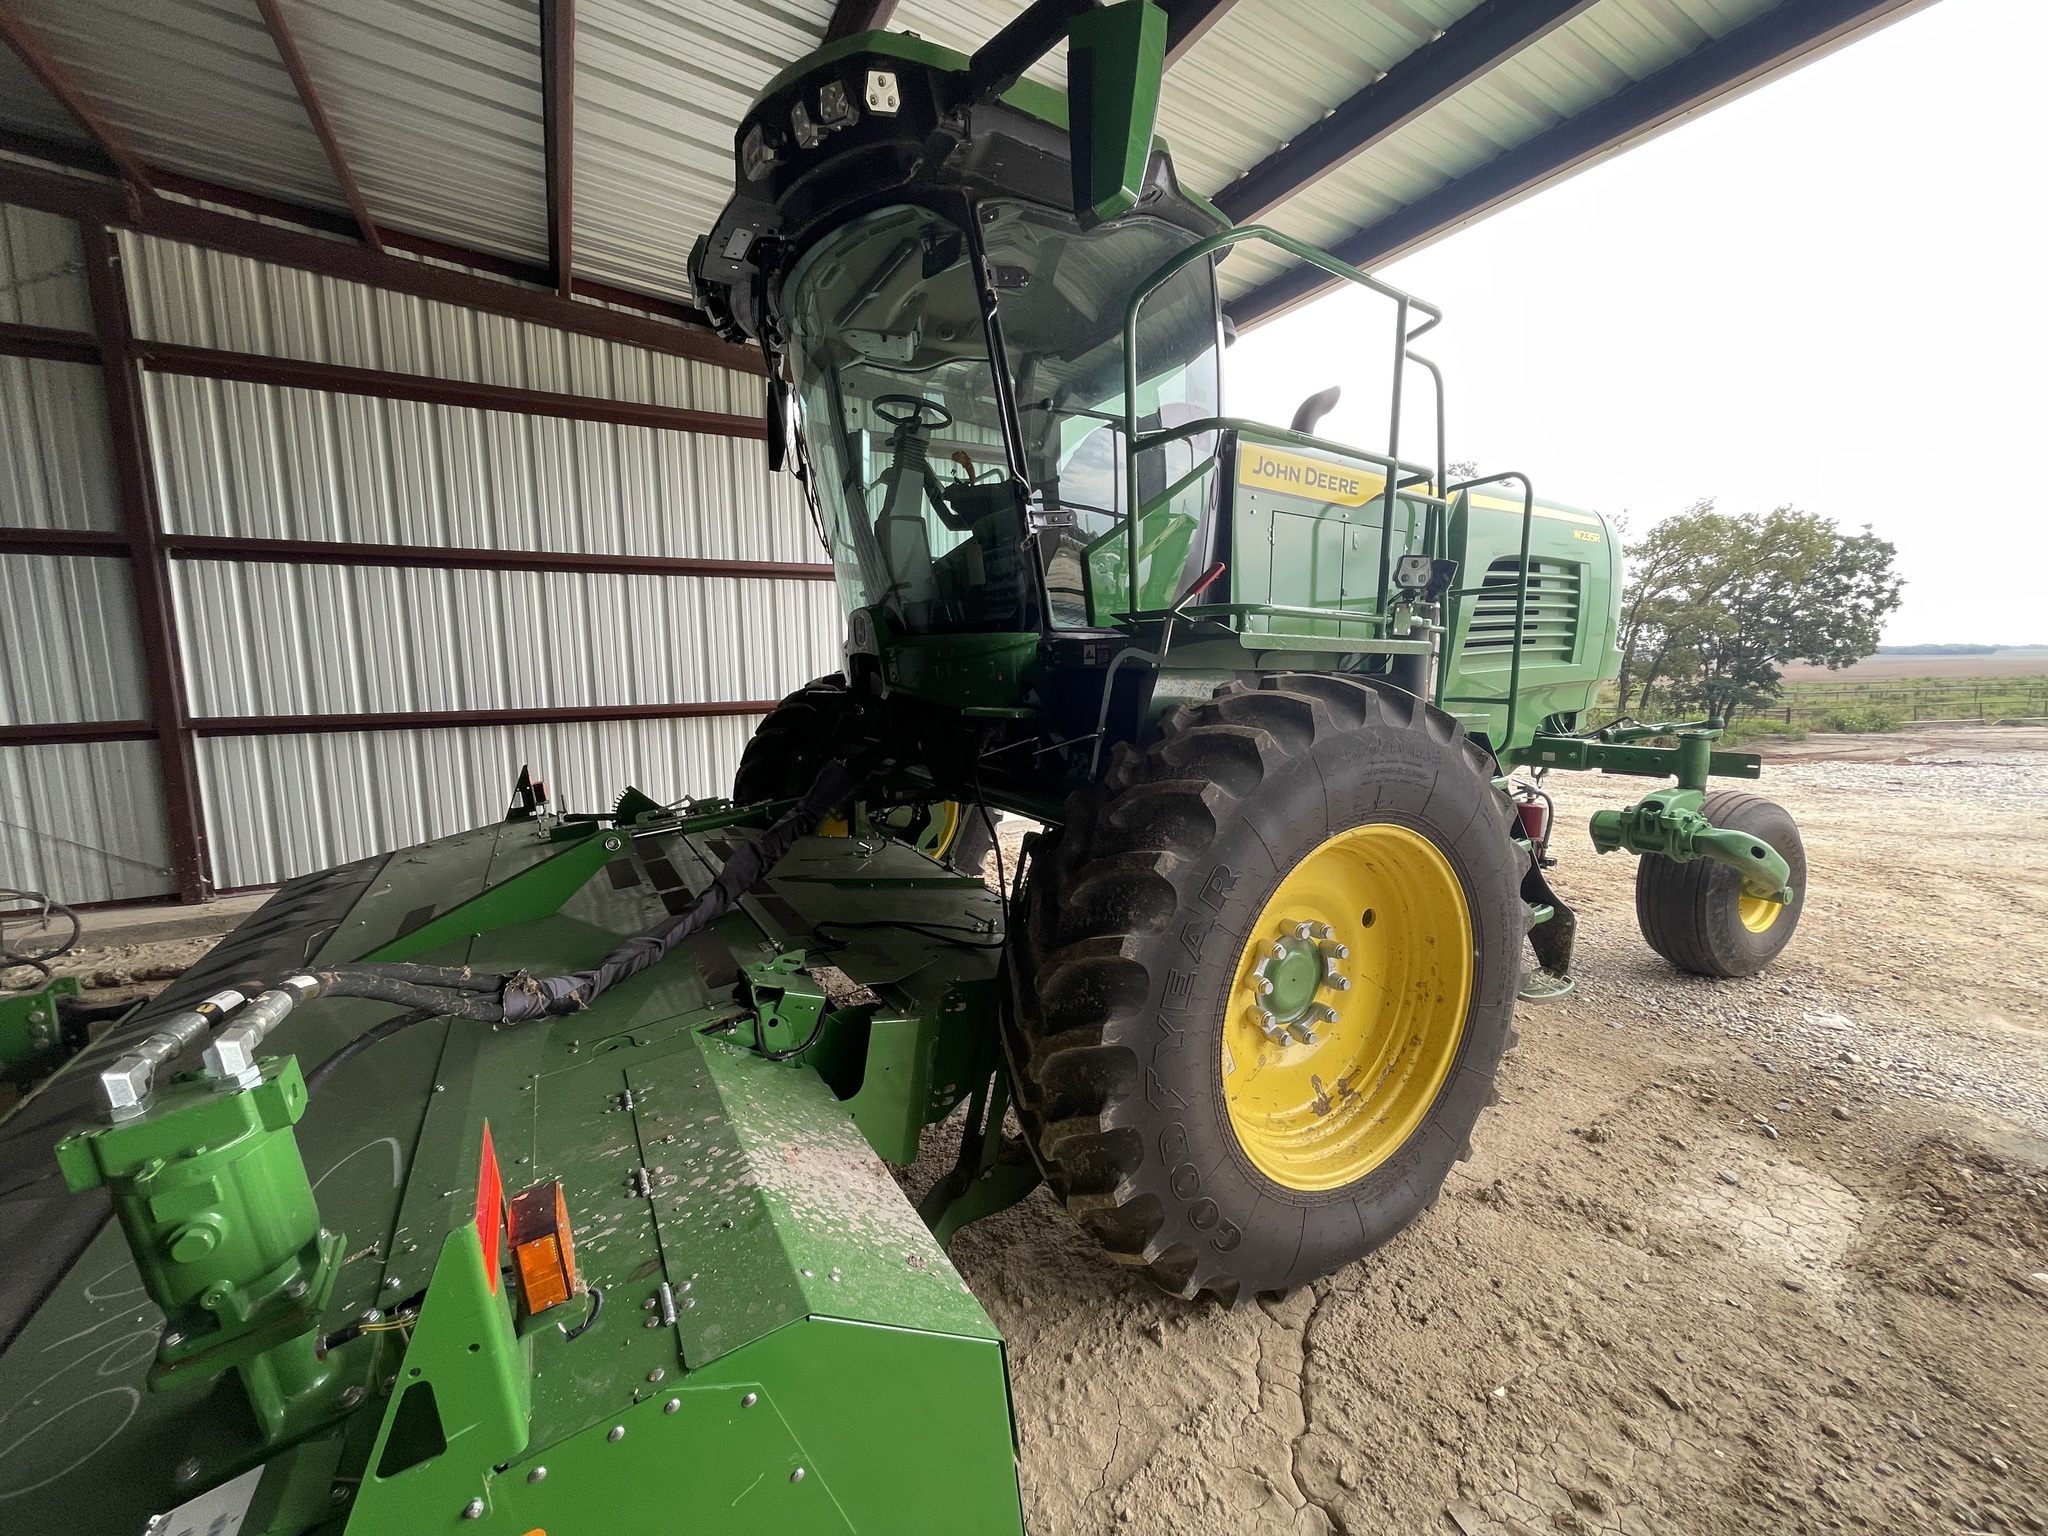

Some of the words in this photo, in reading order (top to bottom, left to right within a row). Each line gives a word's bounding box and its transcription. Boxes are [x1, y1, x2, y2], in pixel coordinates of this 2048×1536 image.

[1252, 455, 1301, 483] JOHN
[1305, 466, 1359, 495] DEERE
[1146, 863, 1242, 1254] GOODYEAR
